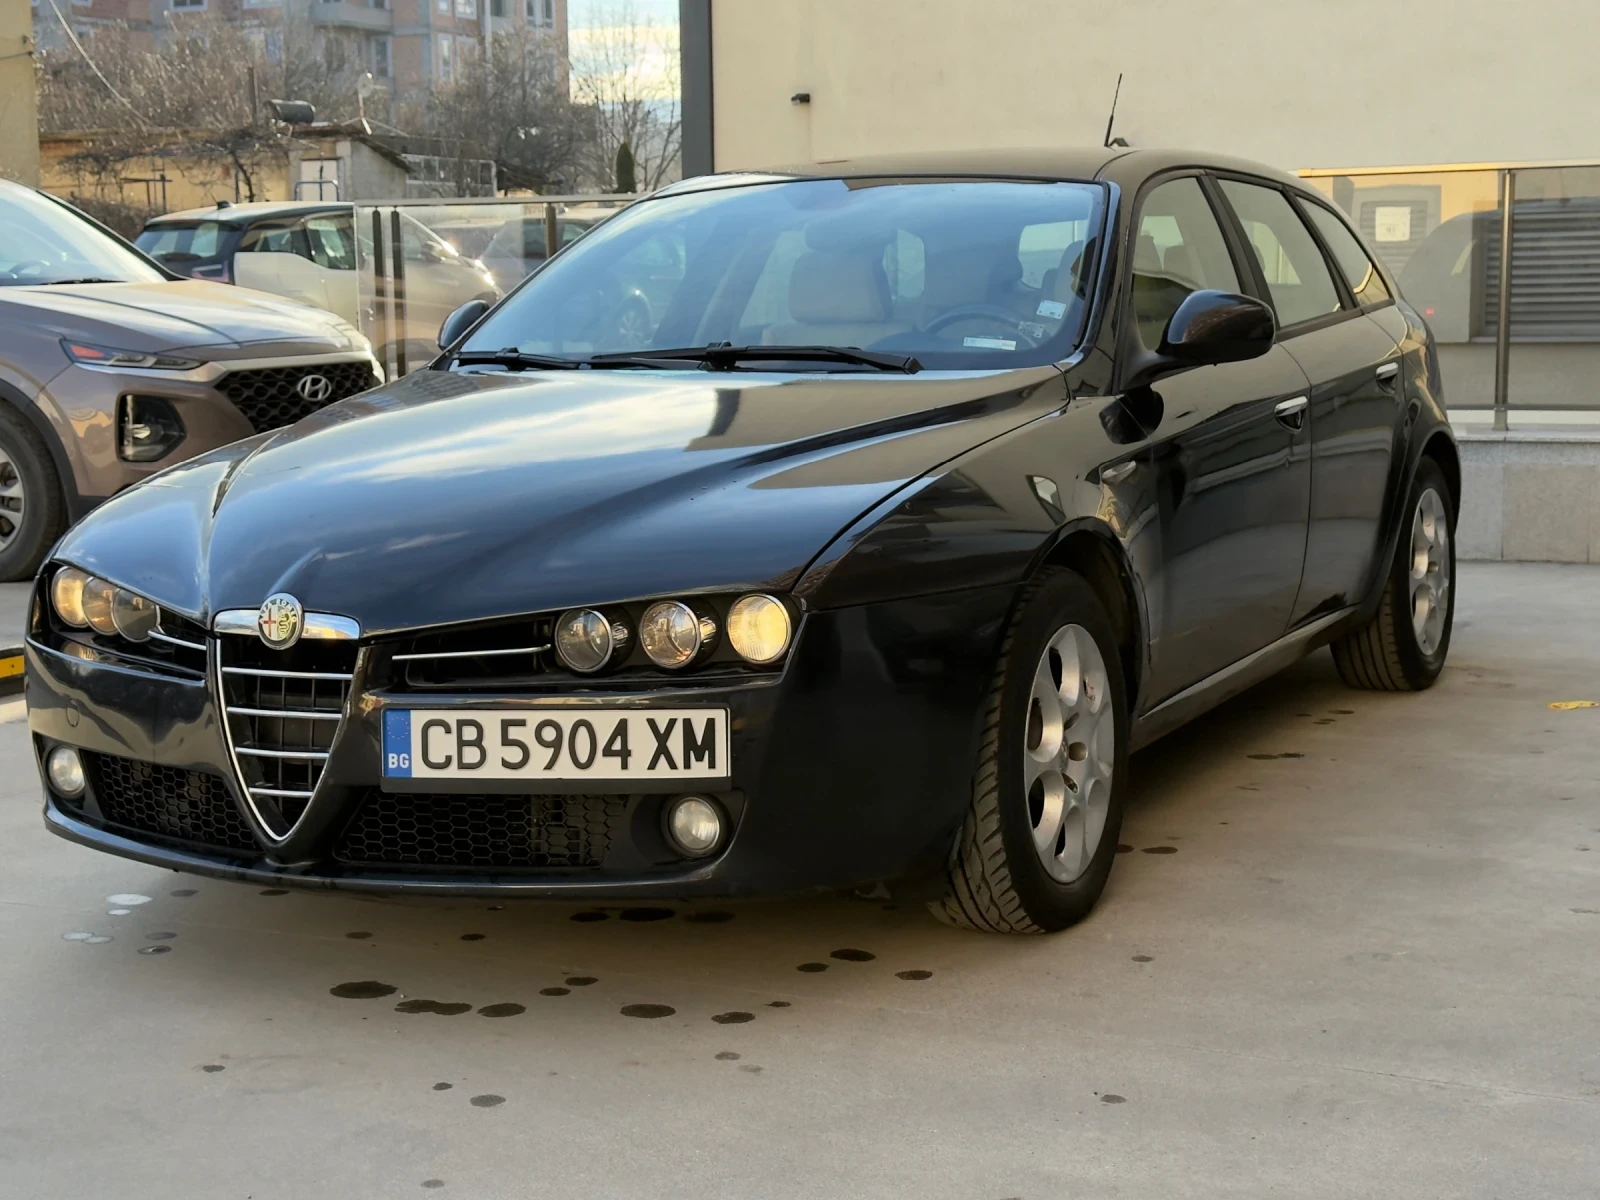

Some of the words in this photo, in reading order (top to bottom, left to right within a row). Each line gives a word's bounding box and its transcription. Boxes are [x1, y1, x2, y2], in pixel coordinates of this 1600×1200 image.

[388, 753, 409, 768] BG
[421, 718, 487, 770] CB
[500, 718, 632, 770] 5904
[646, 718, 716, 770] XM
